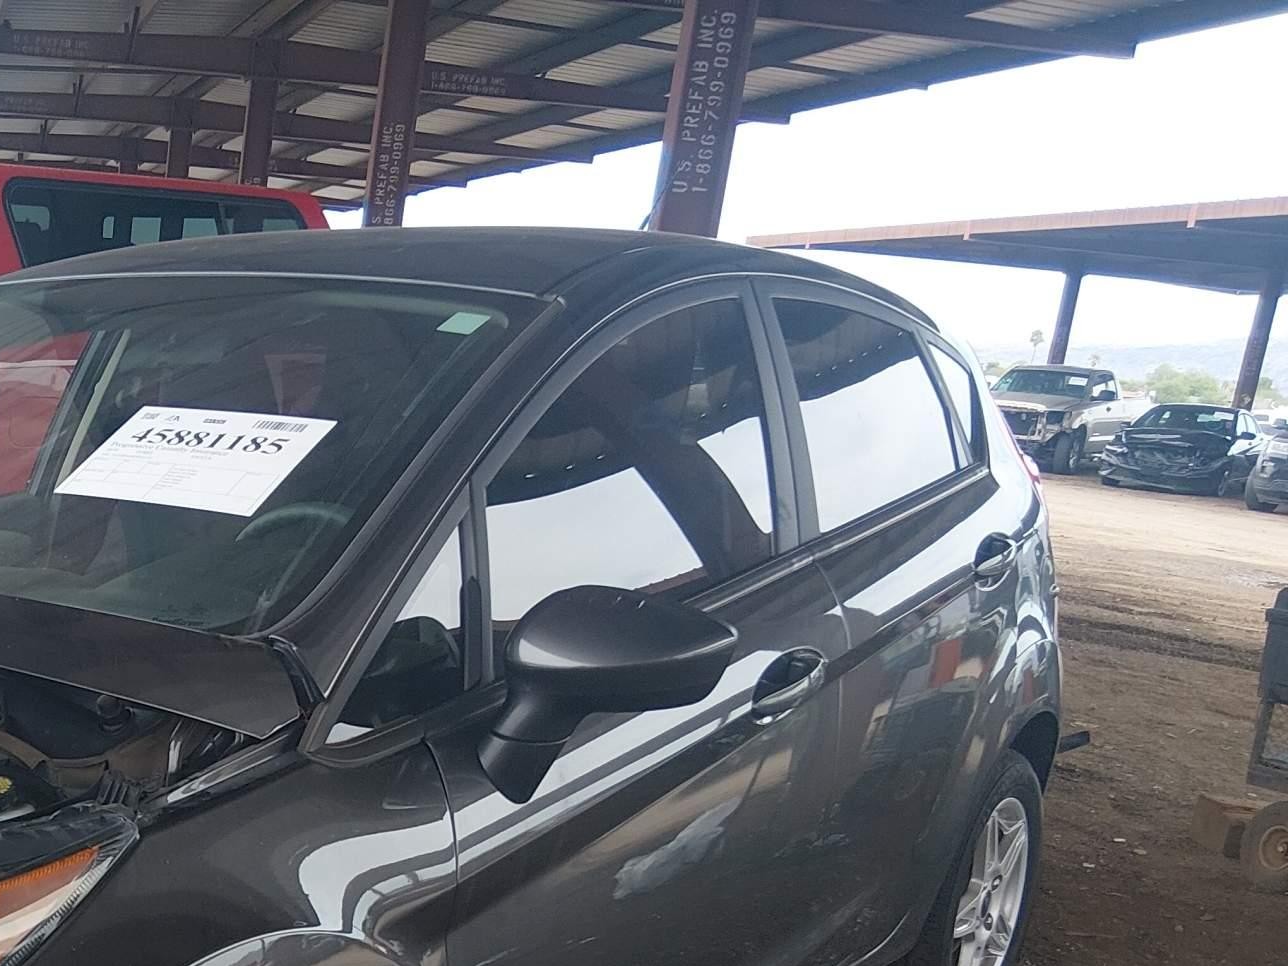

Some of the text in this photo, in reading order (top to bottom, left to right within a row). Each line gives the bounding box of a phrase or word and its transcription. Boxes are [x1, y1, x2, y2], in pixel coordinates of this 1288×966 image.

[681, 60, 709, 142] PREFAB
[696, 9, 718, 49] INC.
[691, 11, 737, 193] 1-866-799-0969
[374, 154, 389, 205] PREFAB
[132, 427, 291, 455] 45881185
